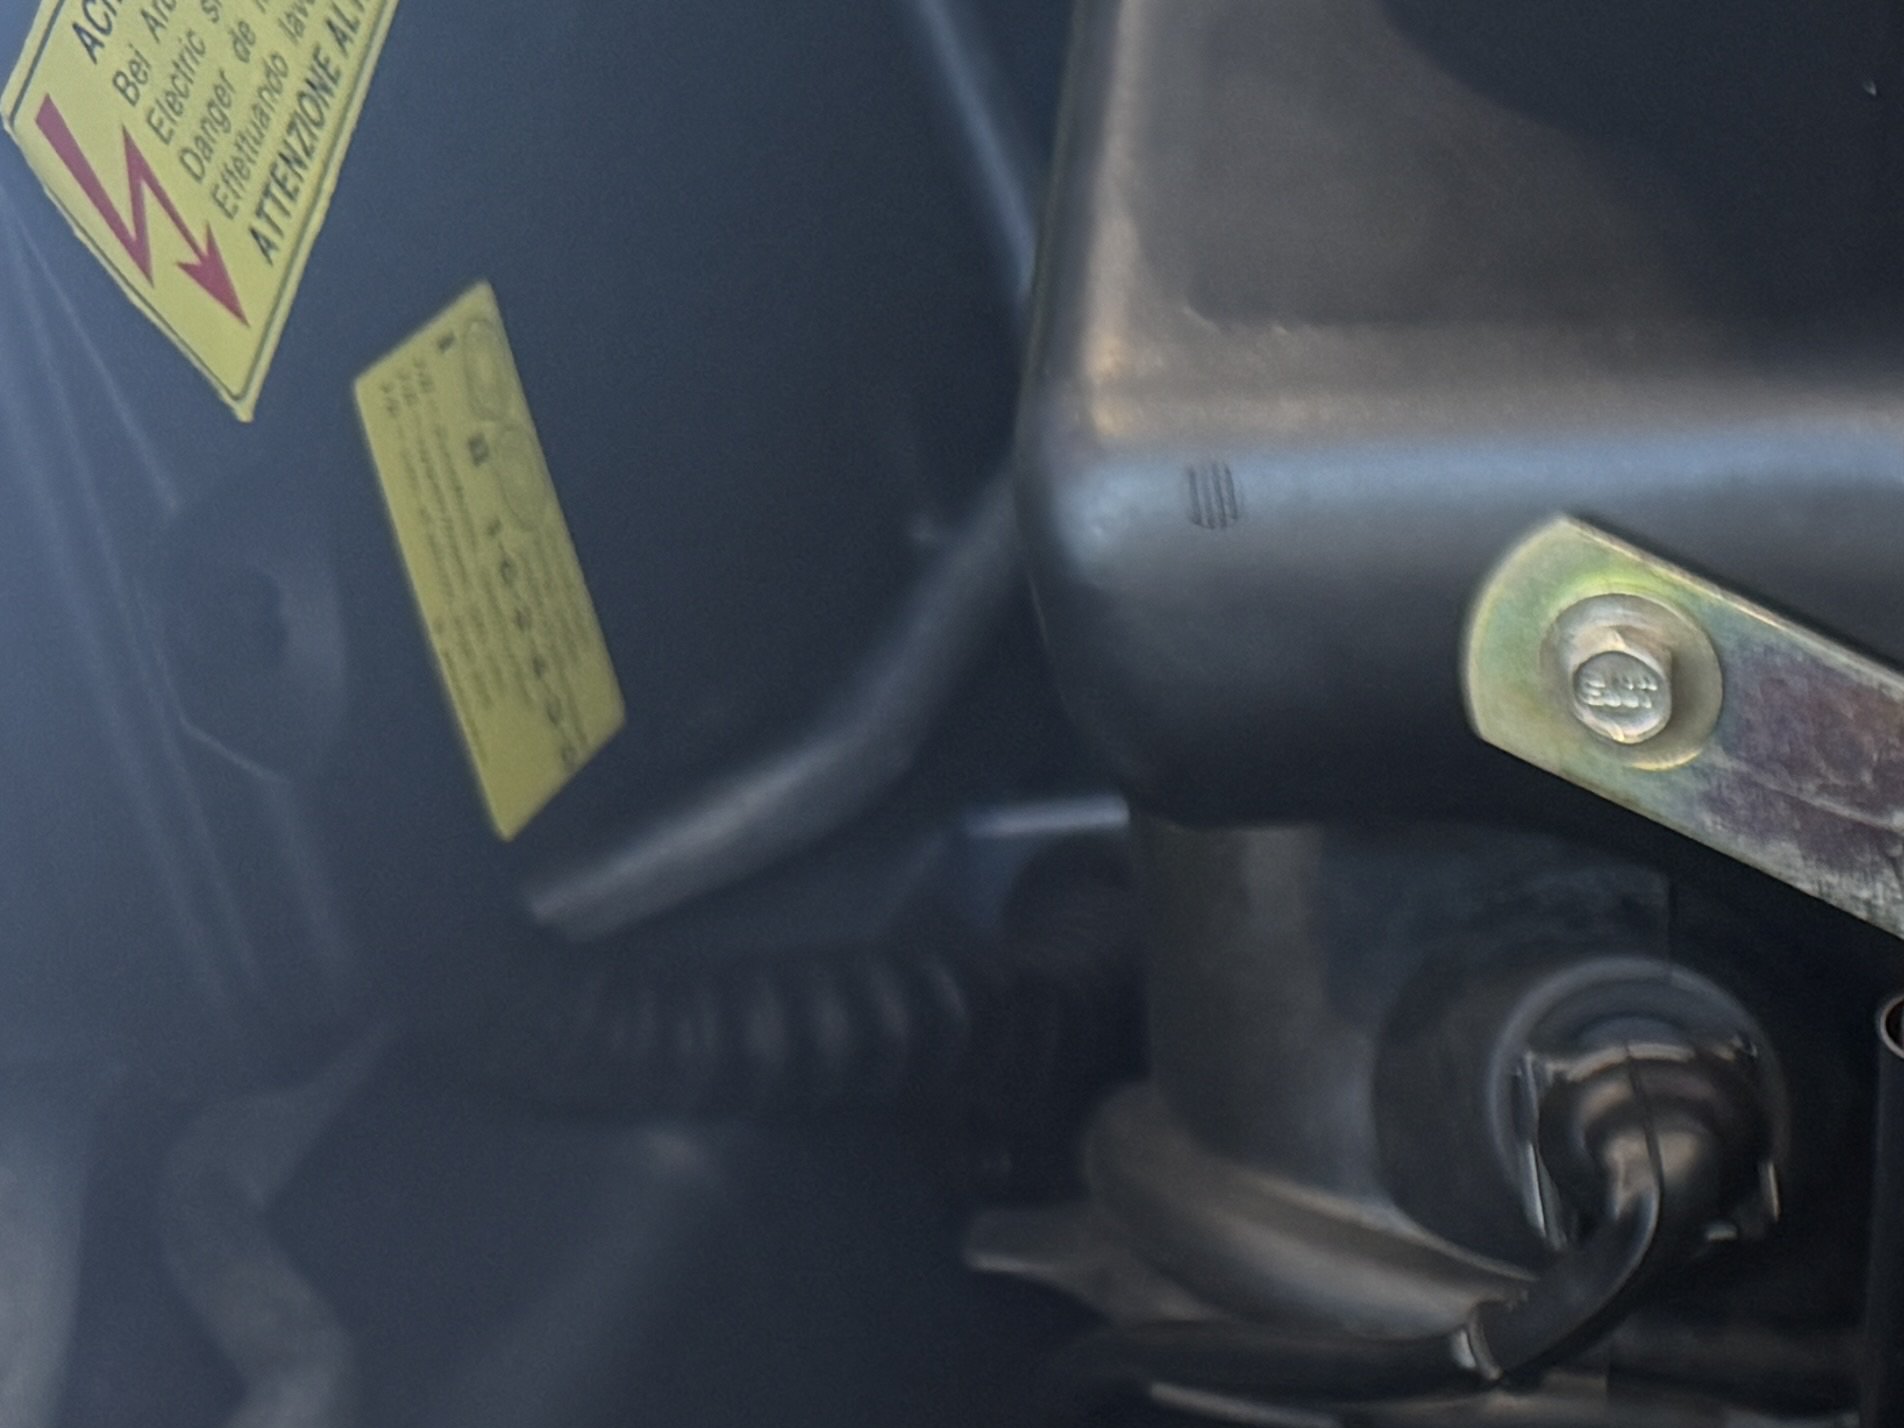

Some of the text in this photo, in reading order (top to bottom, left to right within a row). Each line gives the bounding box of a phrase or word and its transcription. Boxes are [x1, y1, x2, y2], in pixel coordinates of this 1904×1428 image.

[111, 43, 151, 108] Bei
[144, 29, 207, 146] Electric
[178, 67, 237, 184] Danger
[246, 40, 342, 268] ATTENZIONE
